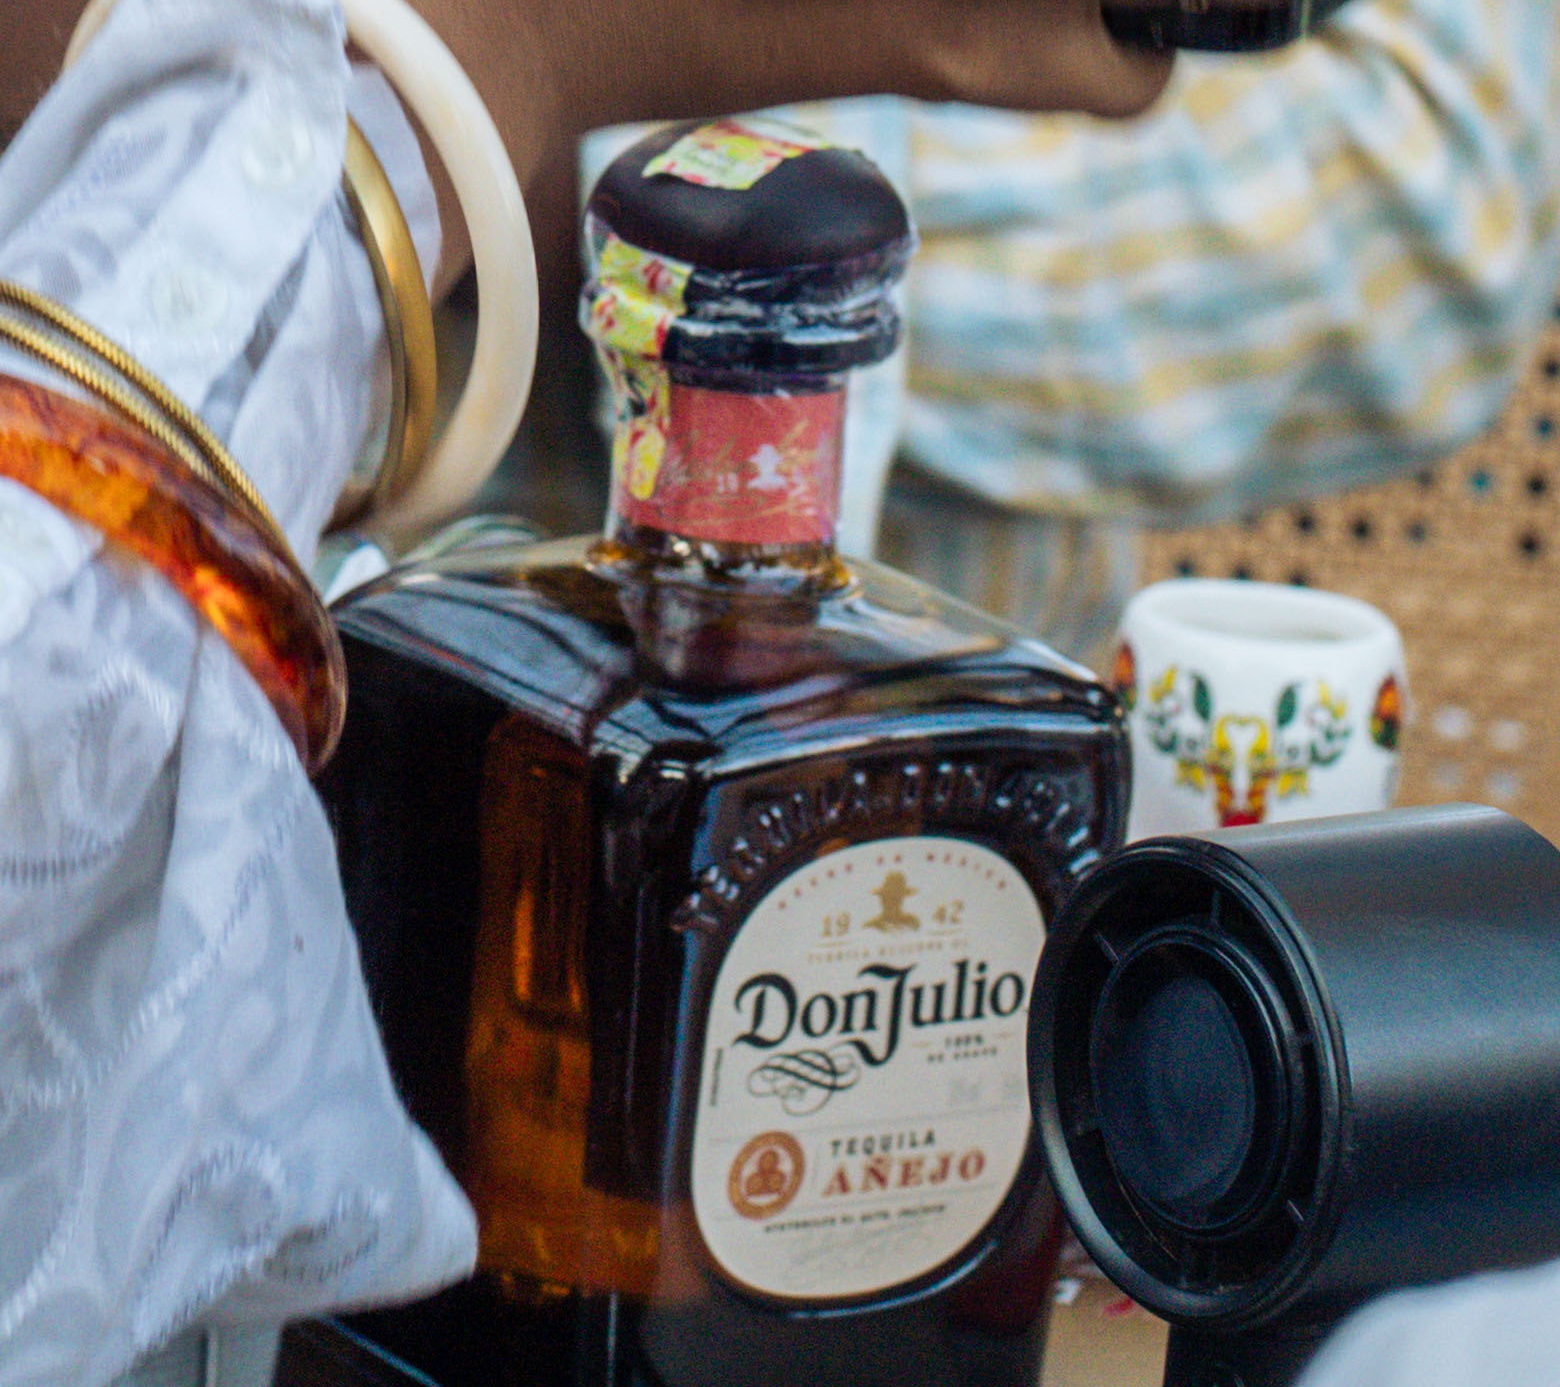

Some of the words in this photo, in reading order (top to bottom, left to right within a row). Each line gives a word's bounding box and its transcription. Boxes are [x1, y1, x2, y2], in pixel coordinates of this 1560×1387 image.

[820, 911, 851, 938] 19
[933, 899, 965, 925] 42
[732, 958, 1026, 1068] DonJulio
[830, 1129, 936, 1157] TEQUILA
[820, 1146, 987, 1198] AÑEJO
